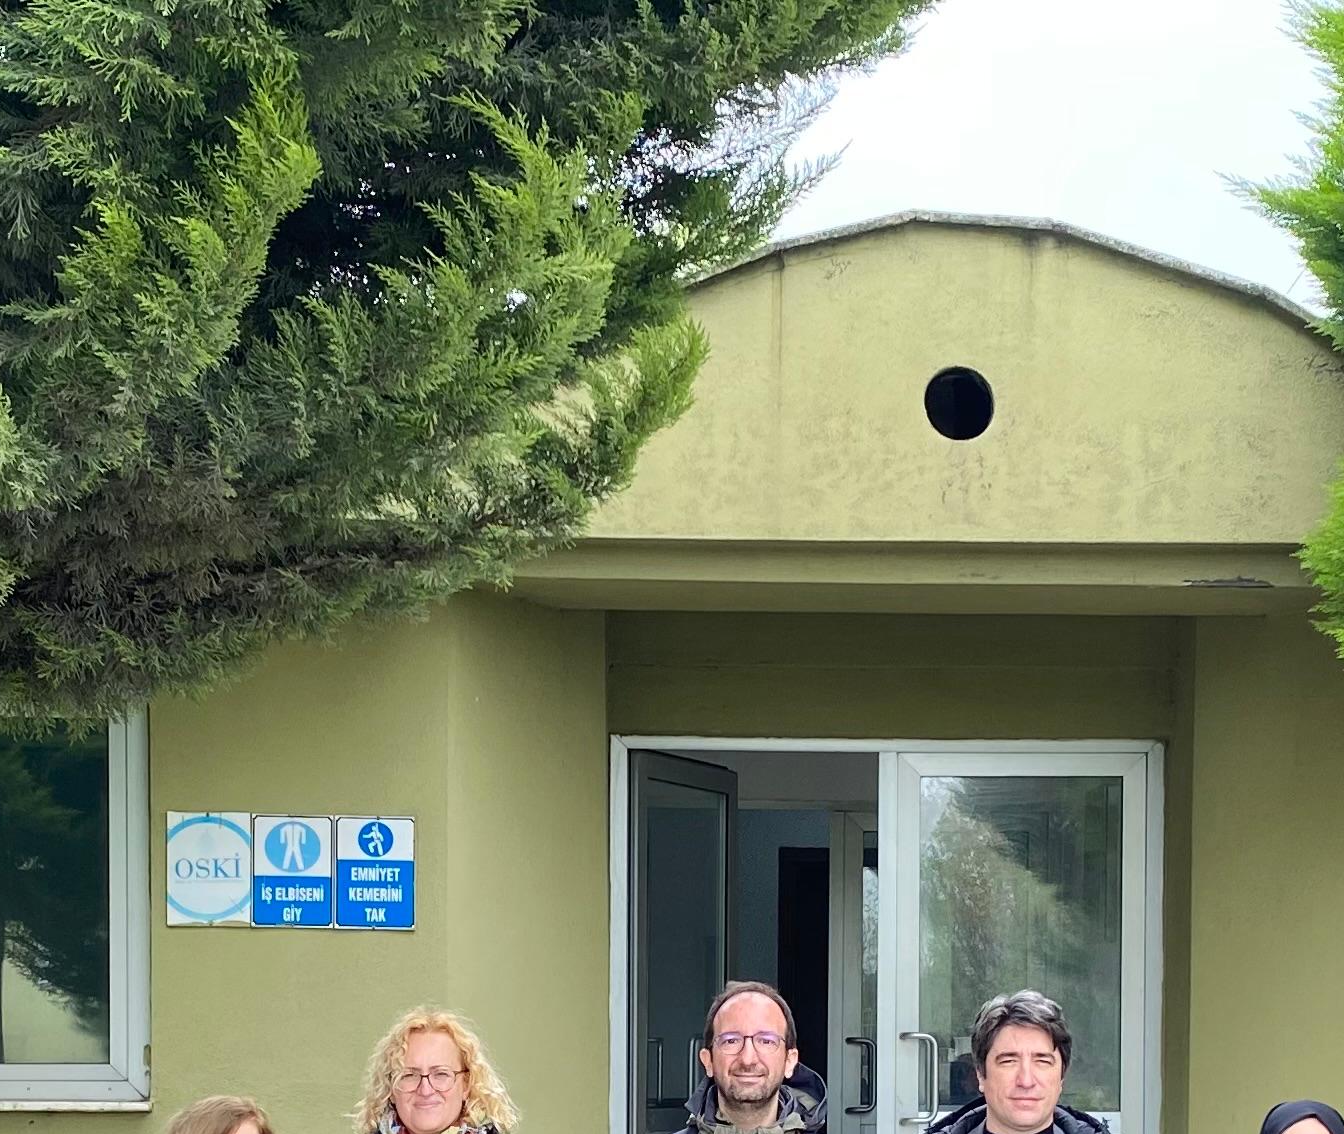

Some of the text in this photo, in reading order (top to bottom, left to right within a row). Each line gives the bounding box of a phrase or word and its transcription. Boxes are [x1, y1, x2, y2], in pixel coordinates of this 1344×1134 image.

[174, 853, 242, 880] OSKİ
[350, 864, 400, 882] EMNİYET
[261, 884, 324, 904] İŞ ELBİSENİ
[348, 885, 402, 903] KEMERİNİ
[282, 906, 302, 922] GİY
[364, 908, 386, 922] TAK
